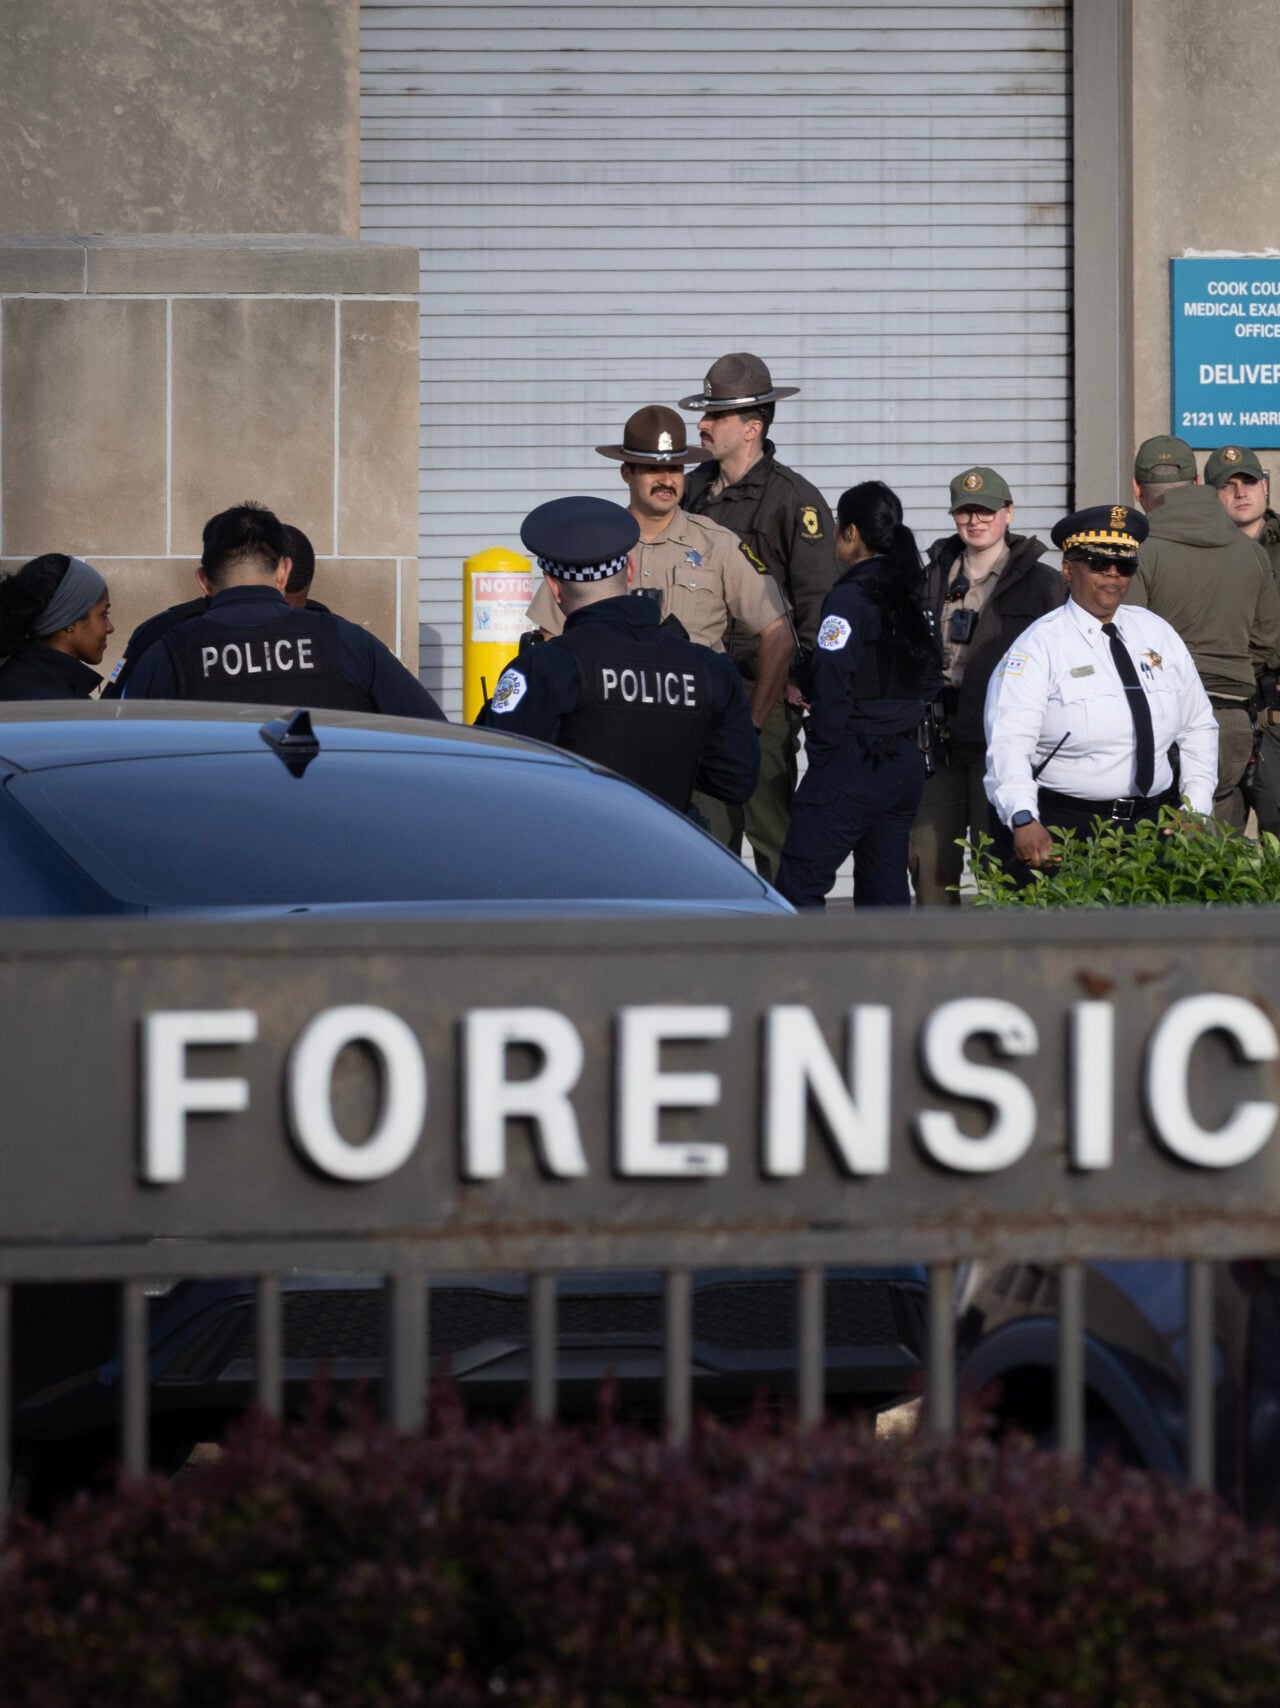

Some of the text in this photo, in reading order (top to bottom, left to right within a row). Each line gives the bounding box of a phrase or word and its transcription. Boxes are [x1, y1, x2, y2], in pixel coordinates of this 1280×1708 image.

[1207, 281, 1248, 296] COOK
[1184, 302, 1246, 317] MEDICAL
[1182, 412, 1214, 427] 2121
[1218, 412, 1237, 427] W.
[201, 638, 315, 678] POLICE
[602, 667, 696, 708] POLICE
